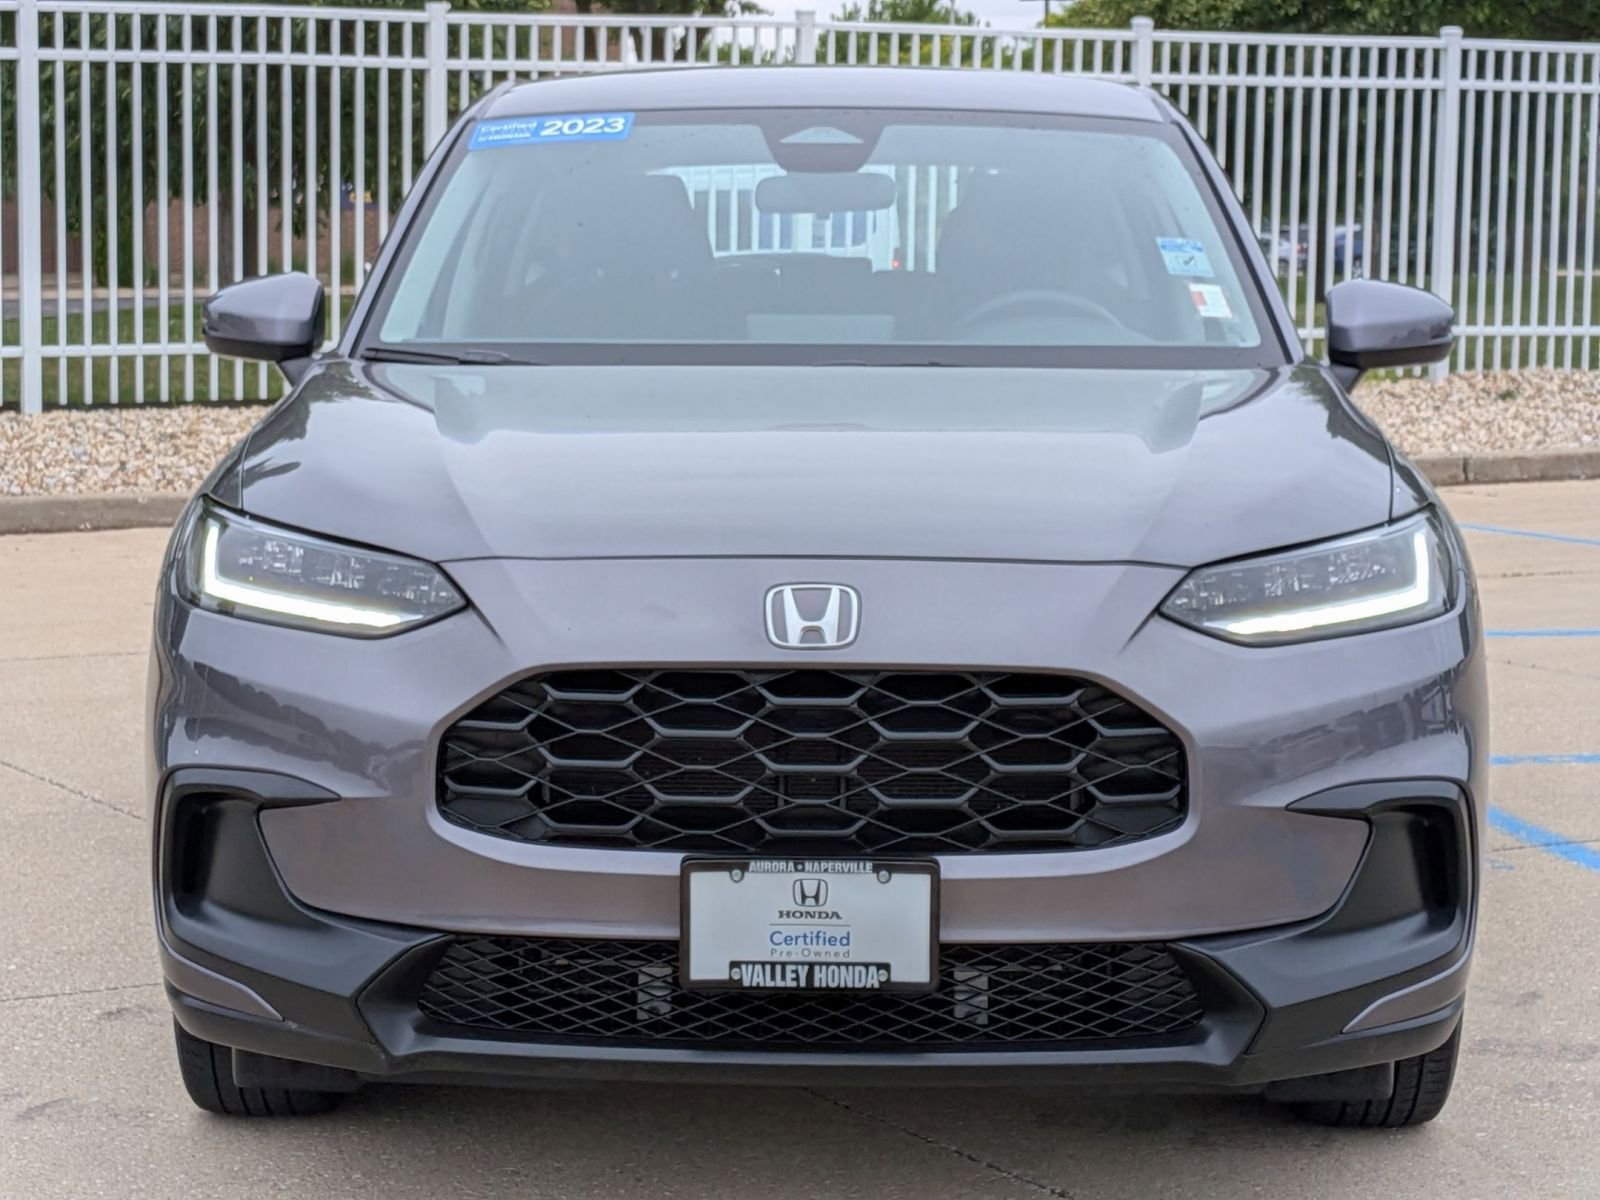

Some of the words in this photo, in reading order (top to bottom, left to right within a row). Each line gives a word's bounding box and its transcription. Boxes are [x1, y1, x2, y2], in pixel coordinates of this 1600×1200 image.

[540, 117, 626, 137] 2023
[749, 861, 795, 873] AURORA
[804, 862, 873, 873] NAPERVILLE
[778, 910, 843, 920] HONDA
[769, 930, 850, 946] Certified
[740, 964, 809, 987] VALLEY
[814, 965, 880, 988] HONDA
